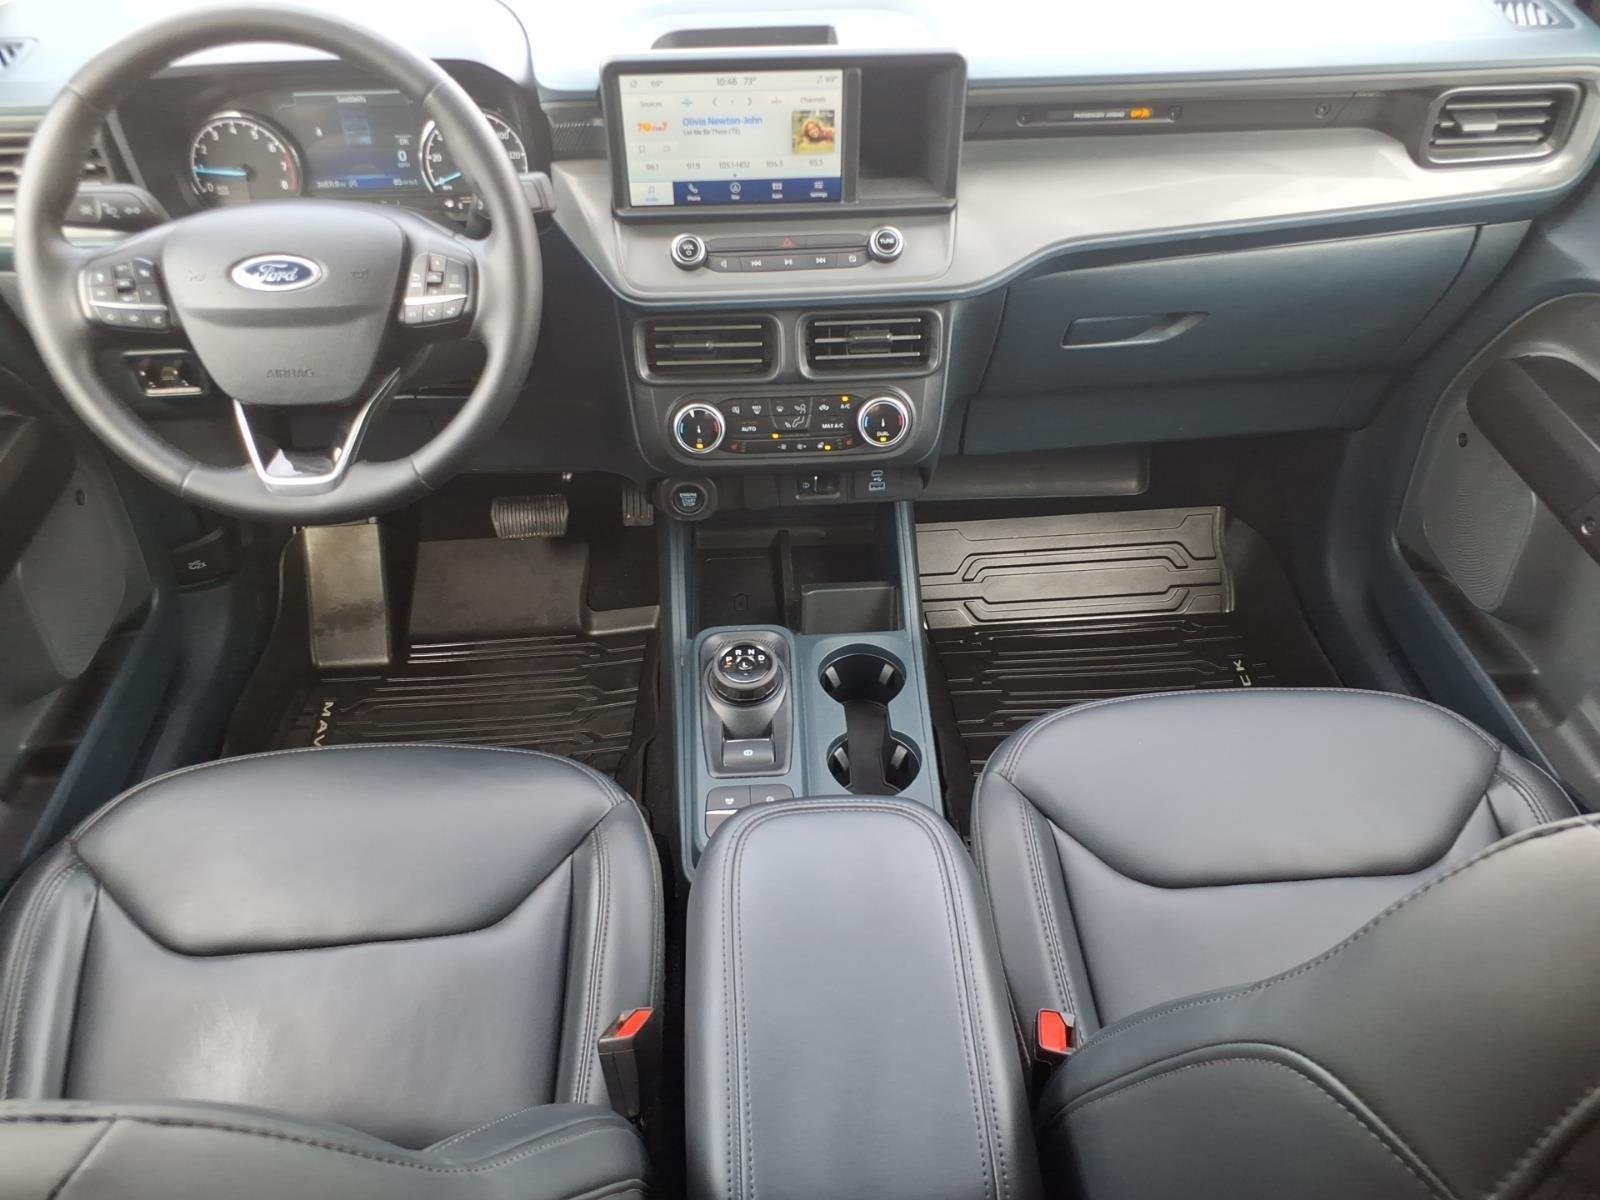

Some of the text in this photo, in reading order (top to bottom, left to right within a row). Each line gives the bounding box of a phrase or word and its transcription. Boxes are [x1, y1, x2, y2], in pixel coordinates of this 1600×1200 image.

[682, 117, 706, 128] Olivia
[432, 153, 442, 162] 20
[258, 263, 299, 282] Ford
[266, 368, 314, 378] AIRBAG
[747, 648, 755, 656] N
